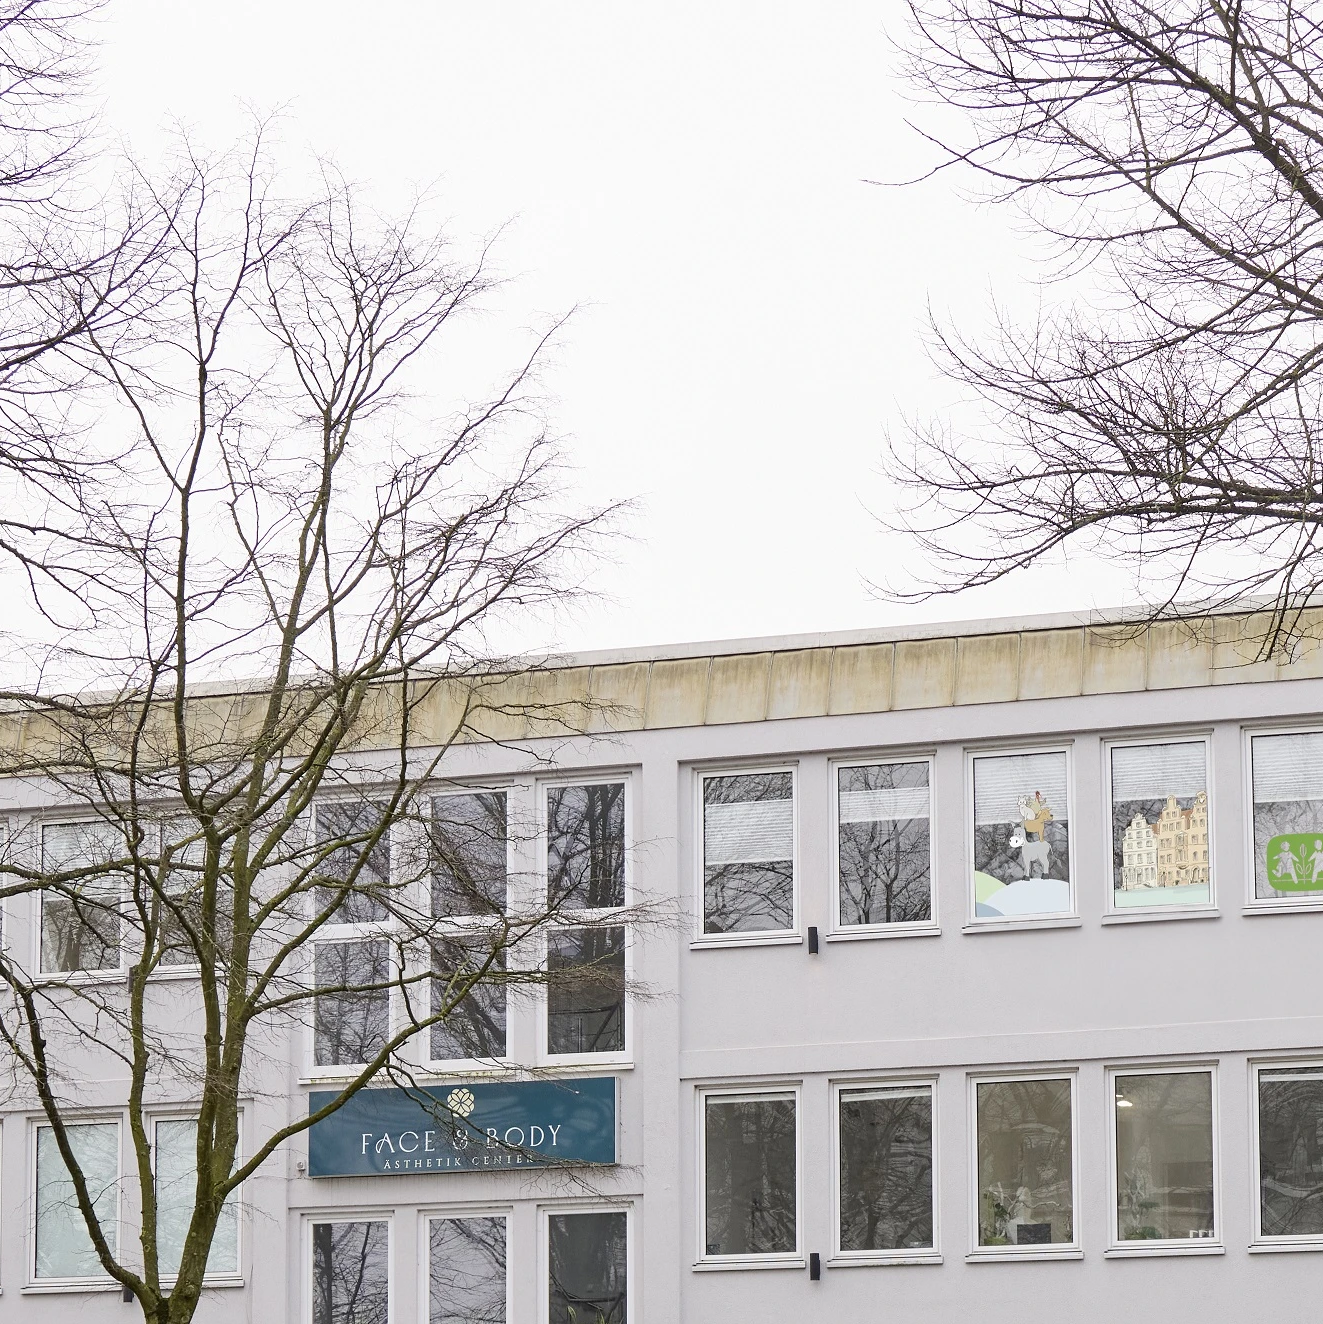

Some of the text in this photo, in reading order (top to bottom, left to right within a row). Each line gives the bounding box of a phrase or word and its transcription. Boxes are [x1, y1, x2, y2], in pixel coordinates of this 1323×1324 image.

[361, 1131, 435, 1154] FACE
[486, 1124, 561, 1149] BODY
[384, 1154, 535, 1169] ÄSTHETIK CENTER
